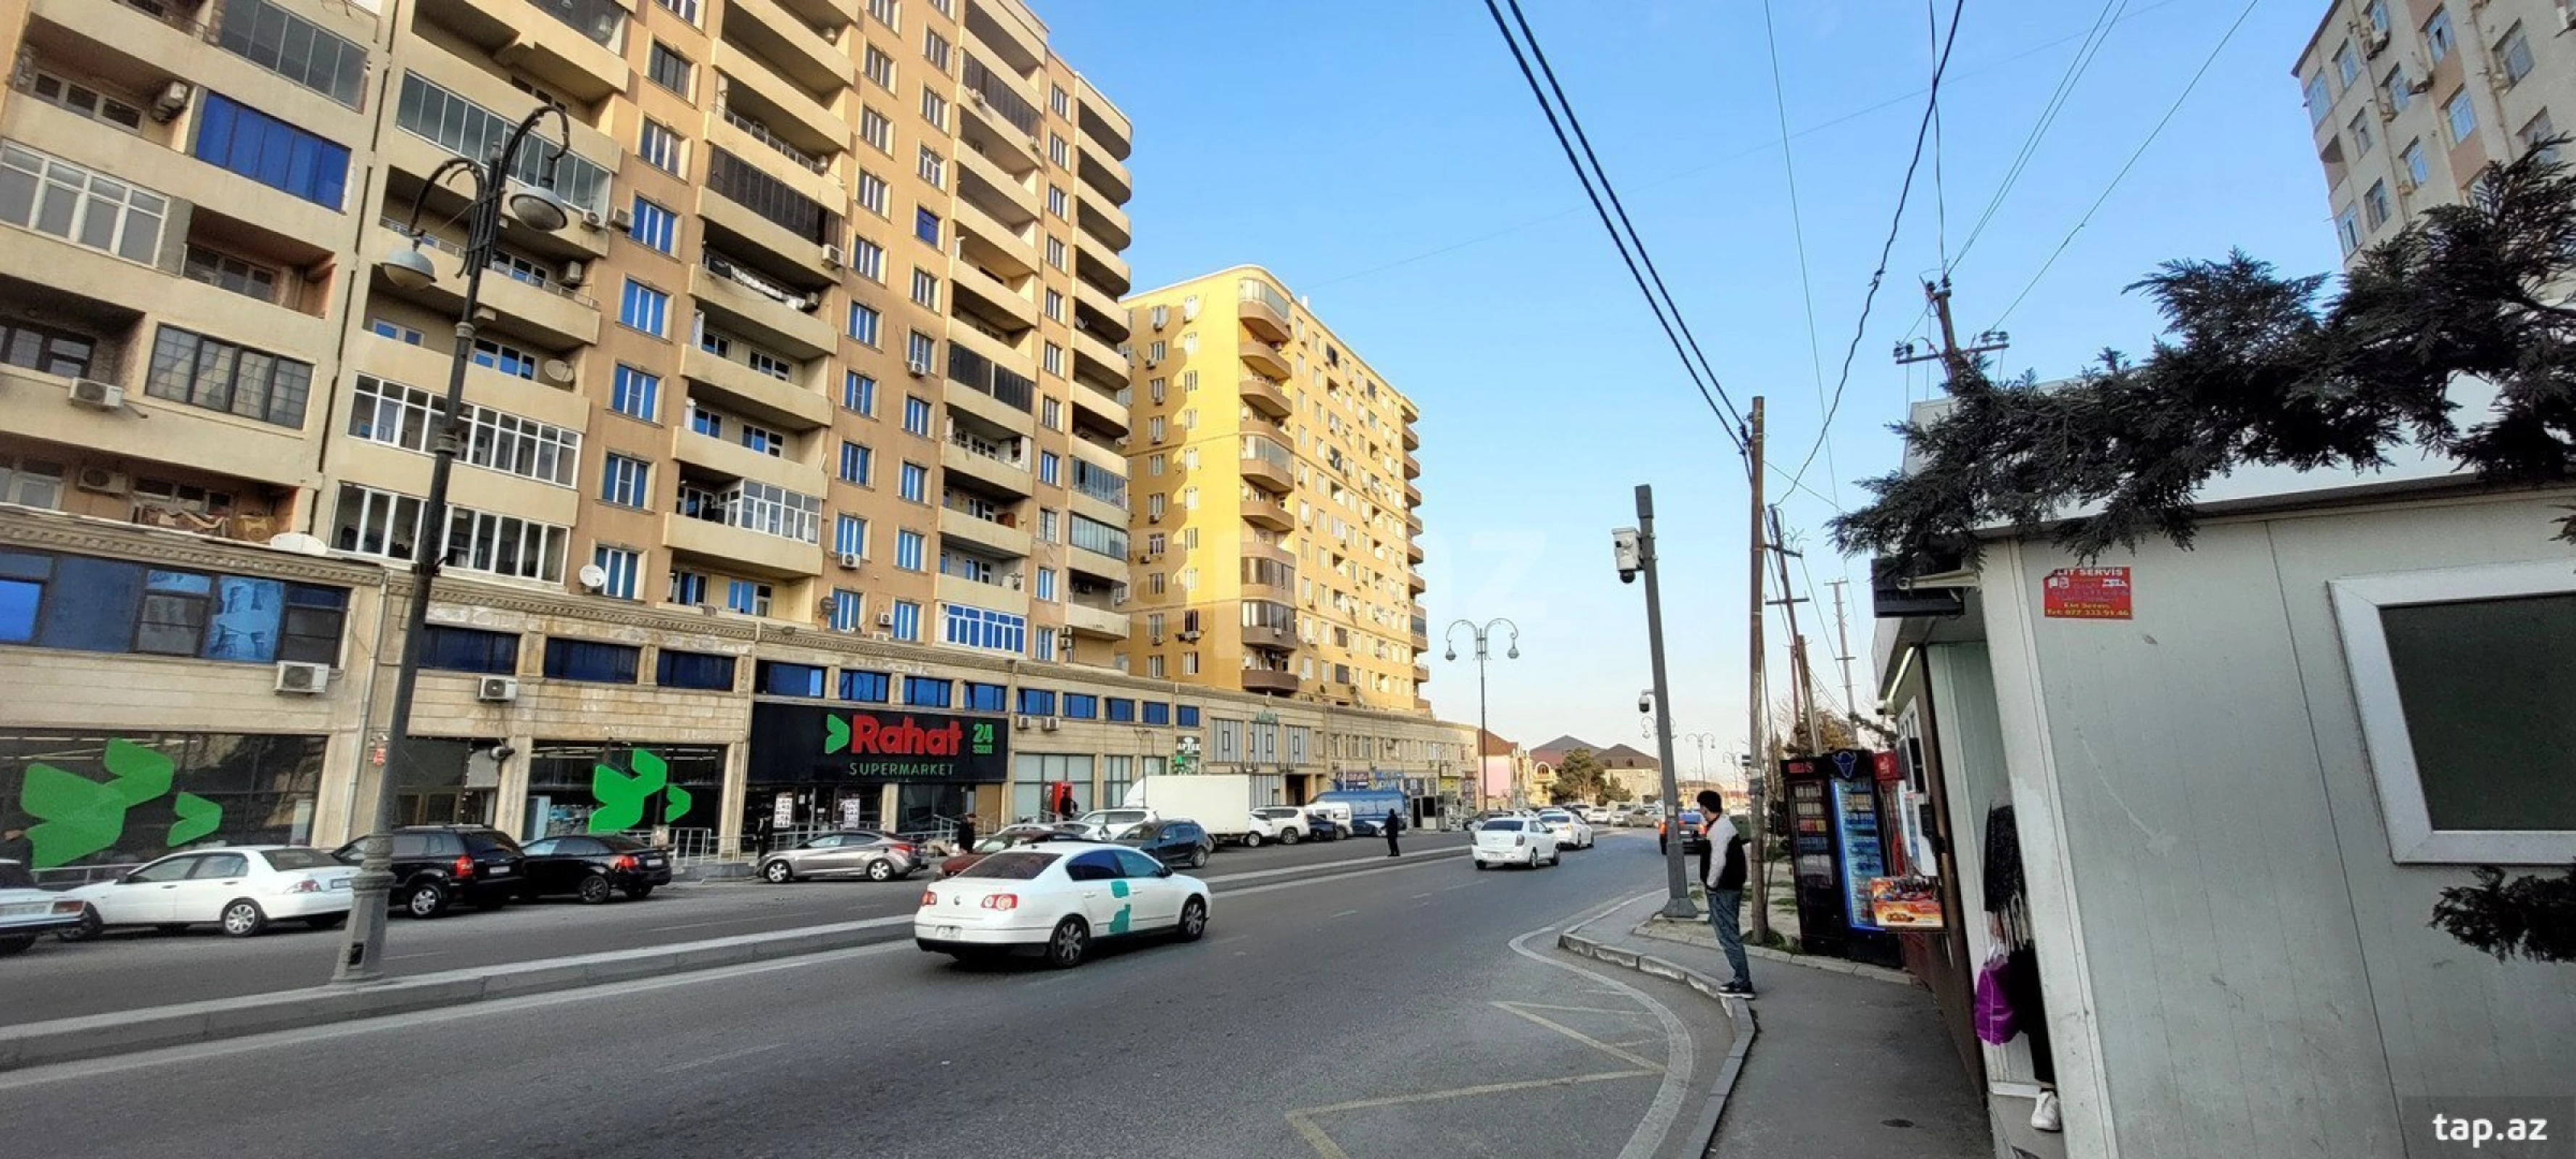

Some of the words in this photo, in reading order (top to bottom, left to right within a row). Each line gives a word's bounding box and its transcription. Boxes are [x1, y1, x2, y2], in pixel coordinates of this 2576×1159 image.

[851, 715, 963, 754] Rahat
[972, 724, 994, 742] 24
[849, 762, 955, 776] SUPERMARKET
